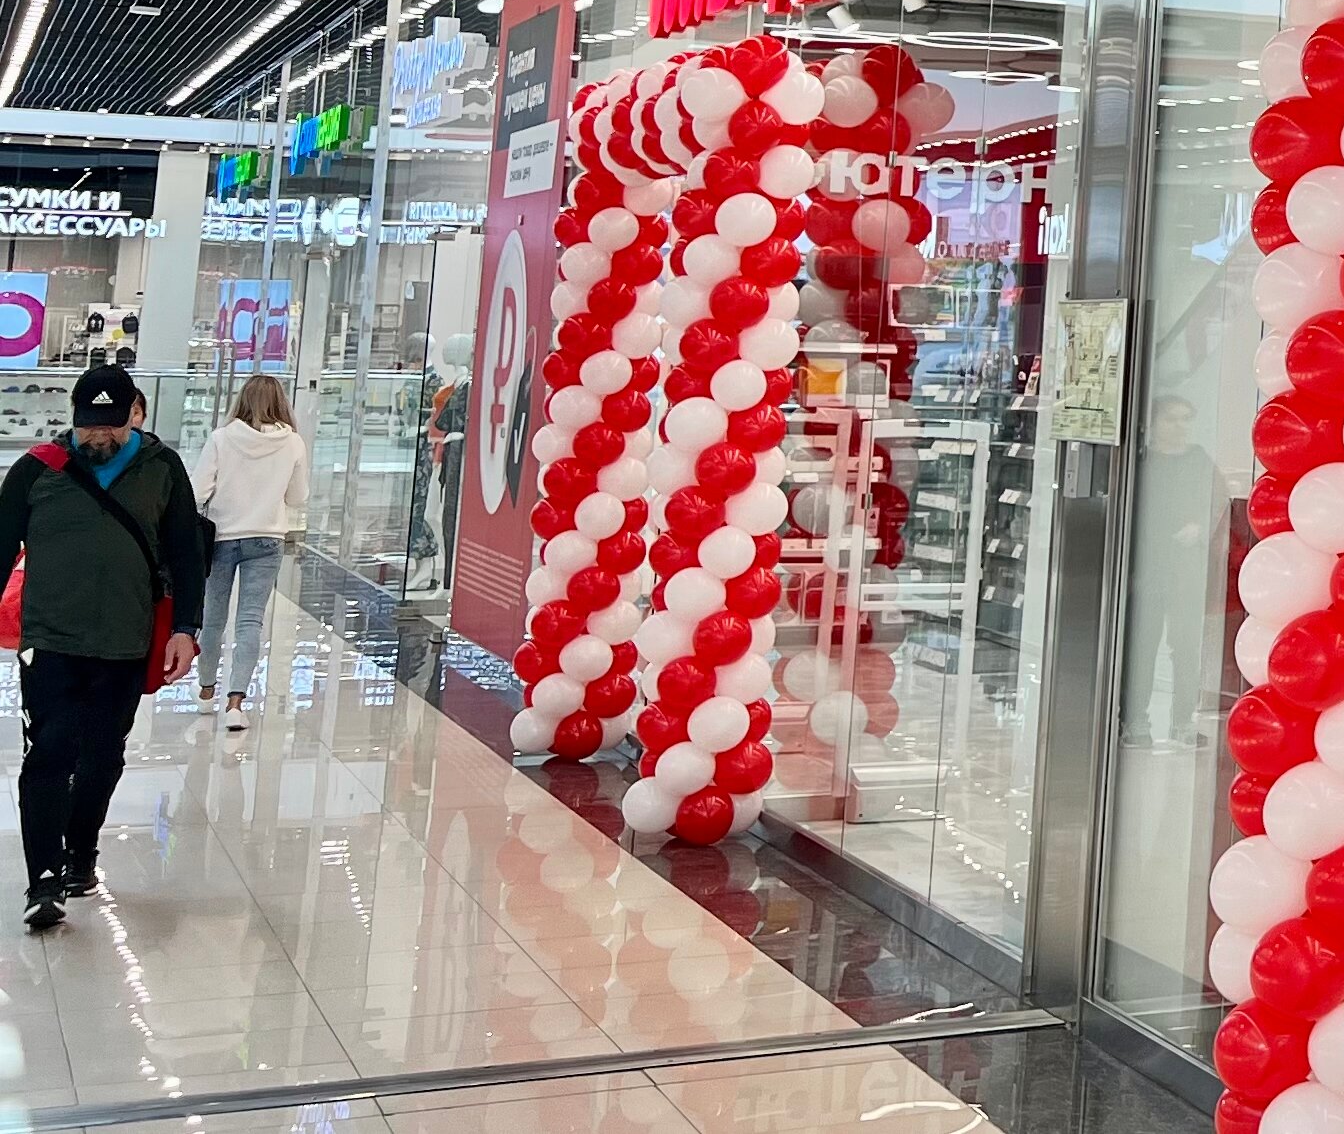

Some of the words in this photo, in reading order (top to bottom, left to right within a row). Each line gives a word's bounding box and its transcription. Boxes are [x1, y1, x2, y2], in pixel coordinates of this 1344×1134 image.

[815, 151, 1053, 215] ютерн
[0, 186, 91, 209] СУМКИ
[99, 191, 121, 211] И
[0, 213, 167, 239] АКСЕССУАРЫ
